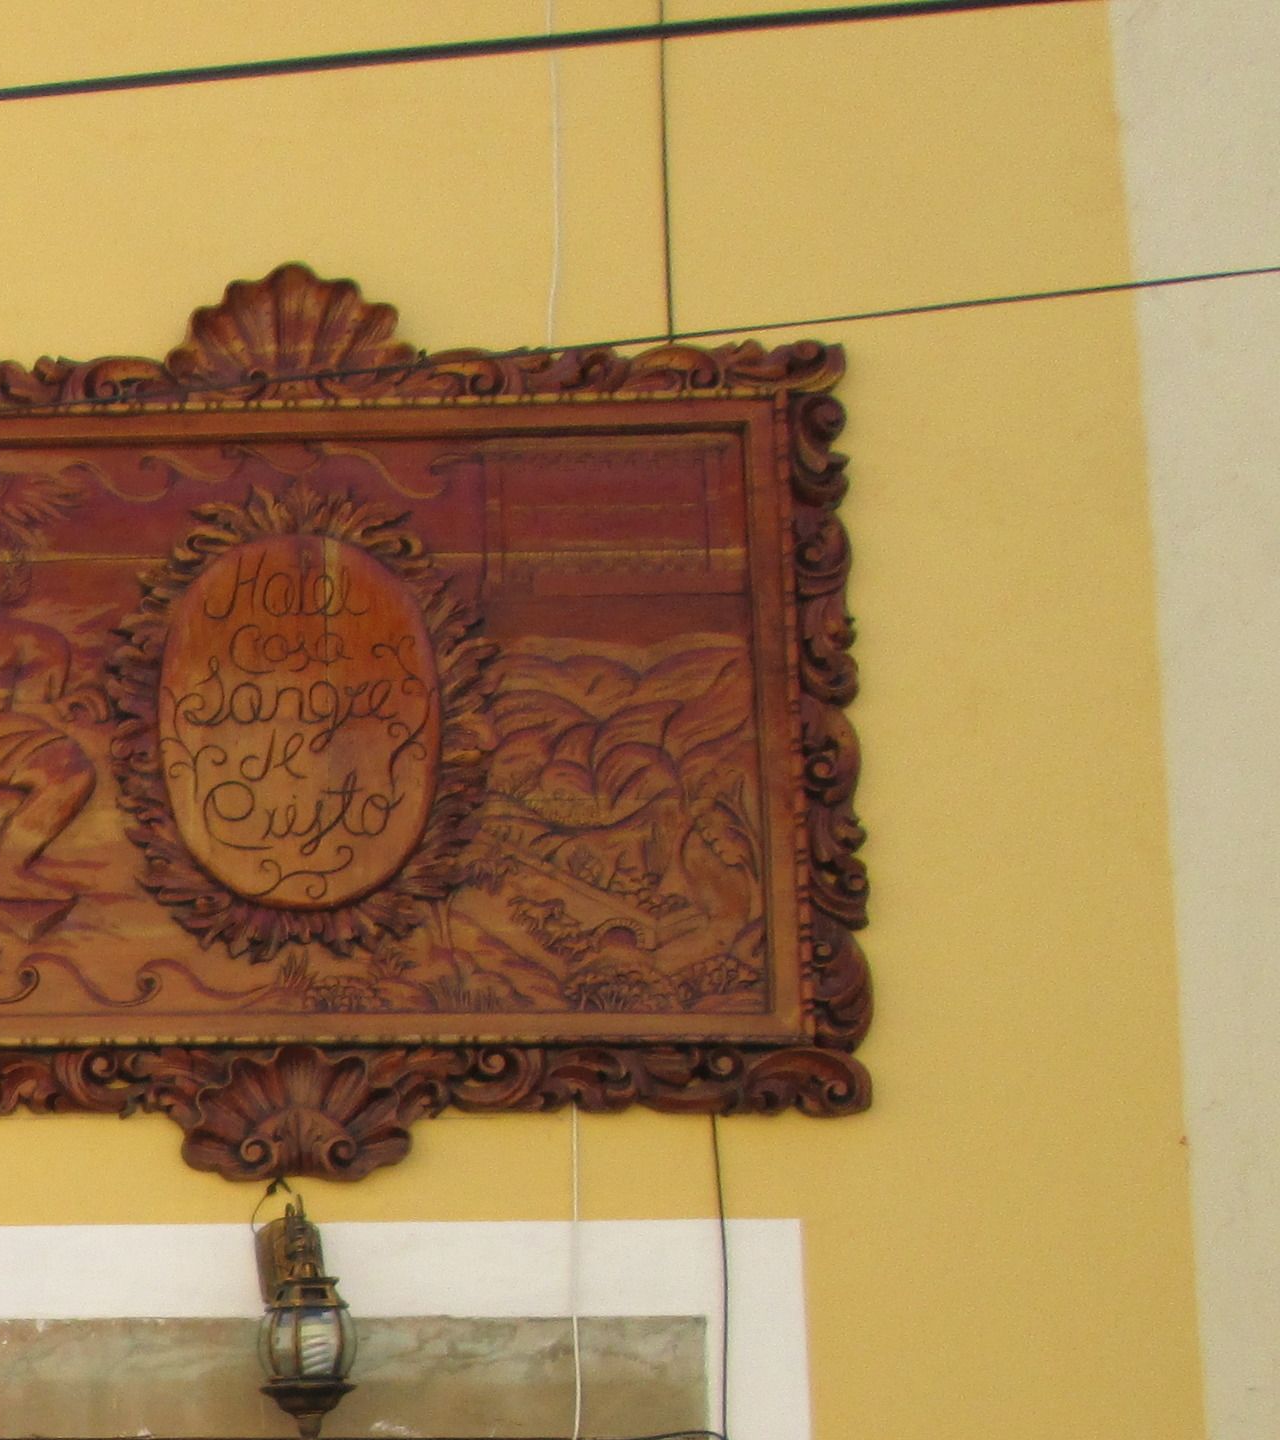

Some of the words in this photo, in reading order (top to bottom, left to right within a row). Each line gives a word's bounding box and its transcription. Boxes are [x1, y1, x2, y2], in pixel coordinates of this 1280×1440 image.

[204, 551, 367, 620] Hotel
[229, 624, 353, 674] Casa
[183, 656, 397, 753] Sangre
[240, 729, 306, 782] de
[203, 771, 404, 855] Cristo
